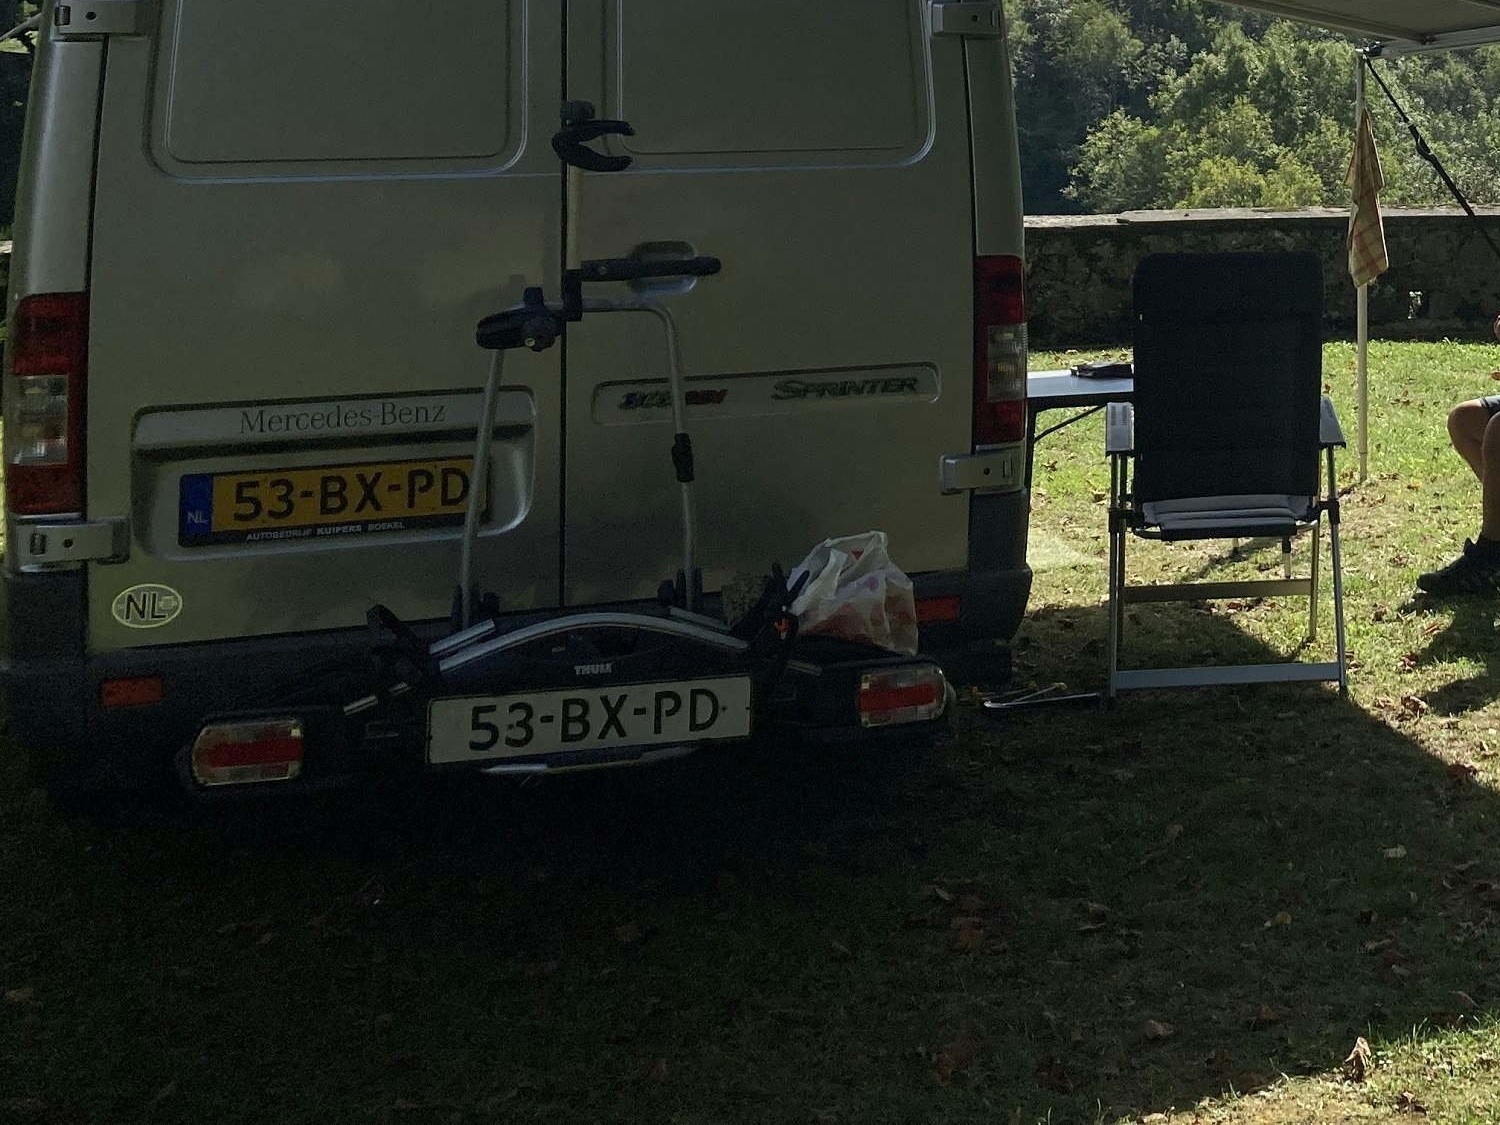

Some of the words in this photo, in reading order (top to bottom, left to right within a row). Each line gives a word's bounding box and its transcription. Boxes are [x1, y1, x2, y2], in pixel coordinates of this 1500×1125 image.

[769, 377, 918, 401] SPRINTER
[240, 402, 446, 433] Mercedes-Benz
[234, 468, 469, 522] 53-BX-PD
[187, 510, 209, 524] NL
[316, 524, 362, 536] KUIPERS
[125, 593, 167, 621] NL
[469, 688, 719, 751] 53-BX-PD
